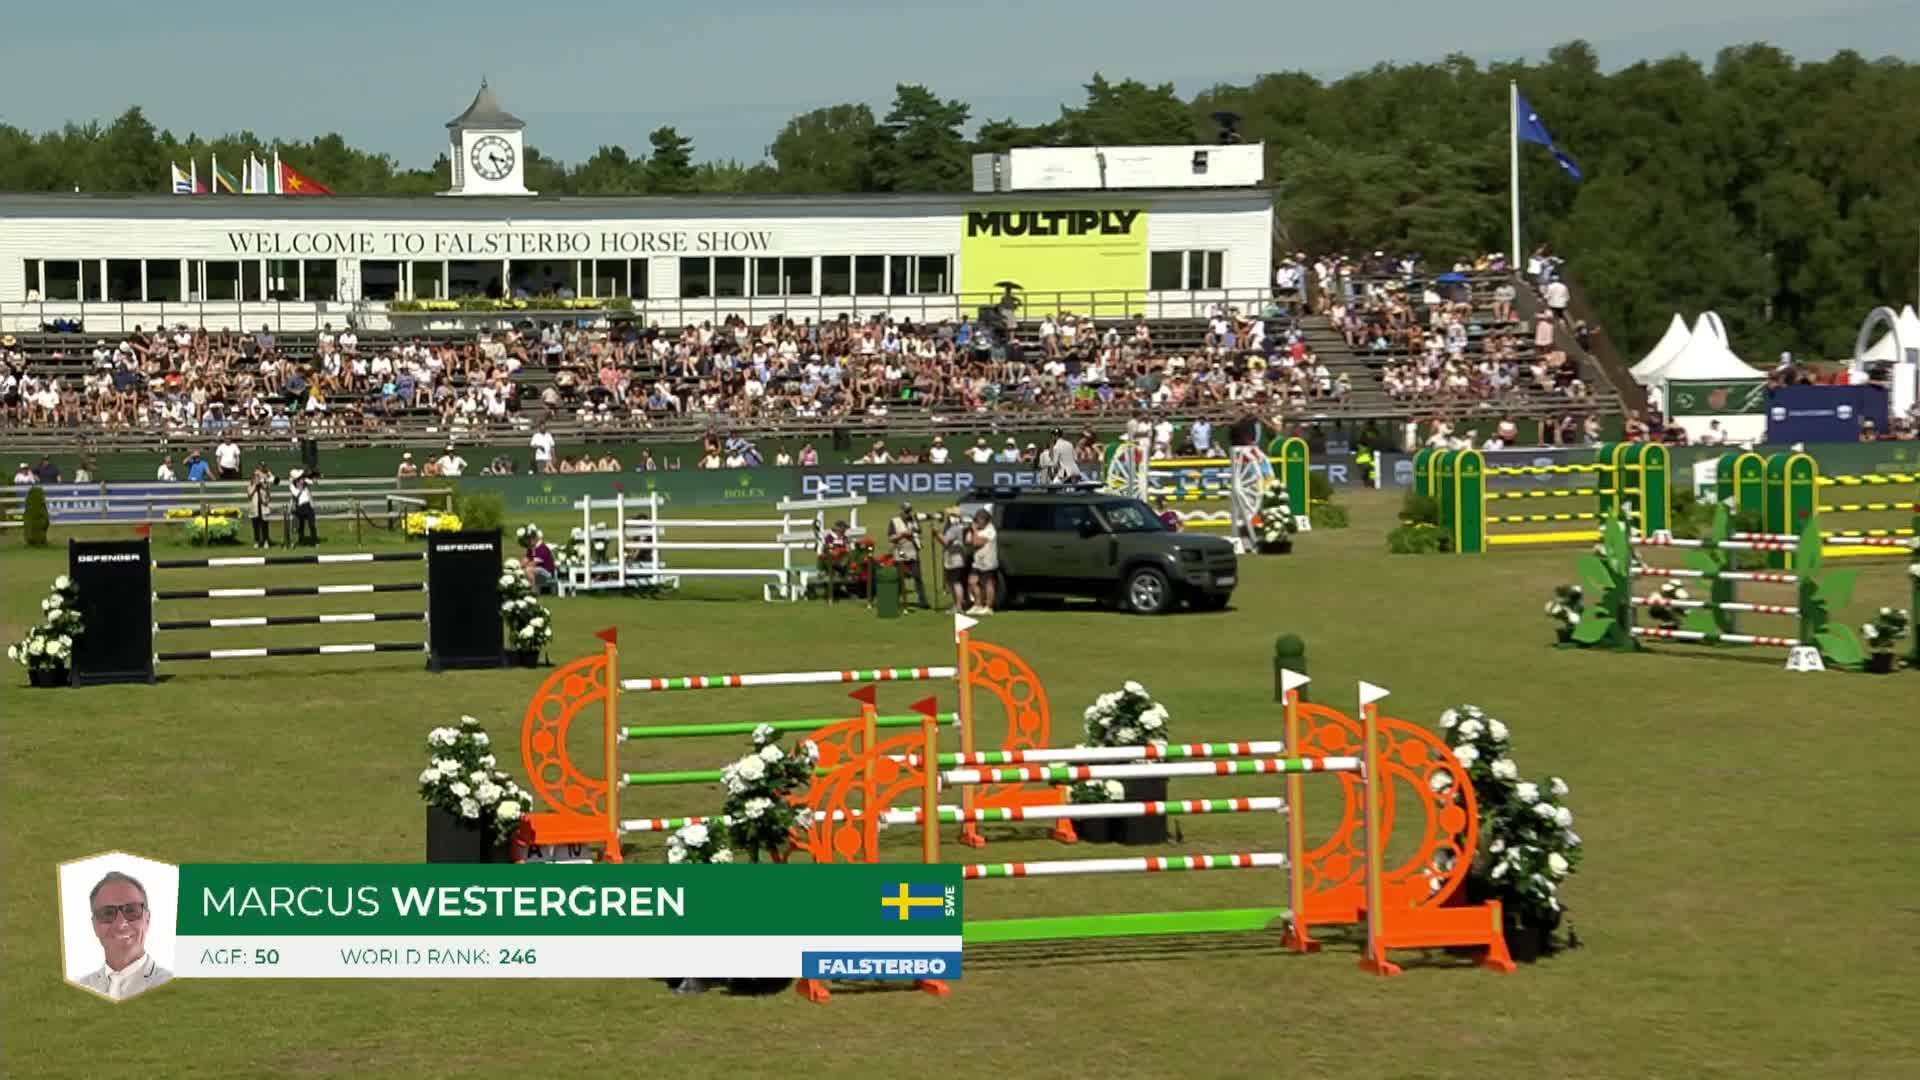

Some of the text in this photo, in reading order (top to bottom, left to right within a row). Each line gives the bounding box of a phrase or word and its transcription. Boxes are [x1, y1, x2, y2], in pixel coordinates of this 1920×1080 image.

[967, 209, 1142, 237] MULTIPLY
[228, 231, 772, 254] WELCOME TO FALSTERBO HORSE SHOW
[802, 472, 974, 494] DEFENDER
[526, 495, 569, 505] ROLEX
[436, 543, 494, 552] DEFENDER
[77, 553, 141, 563] DEFENDER
